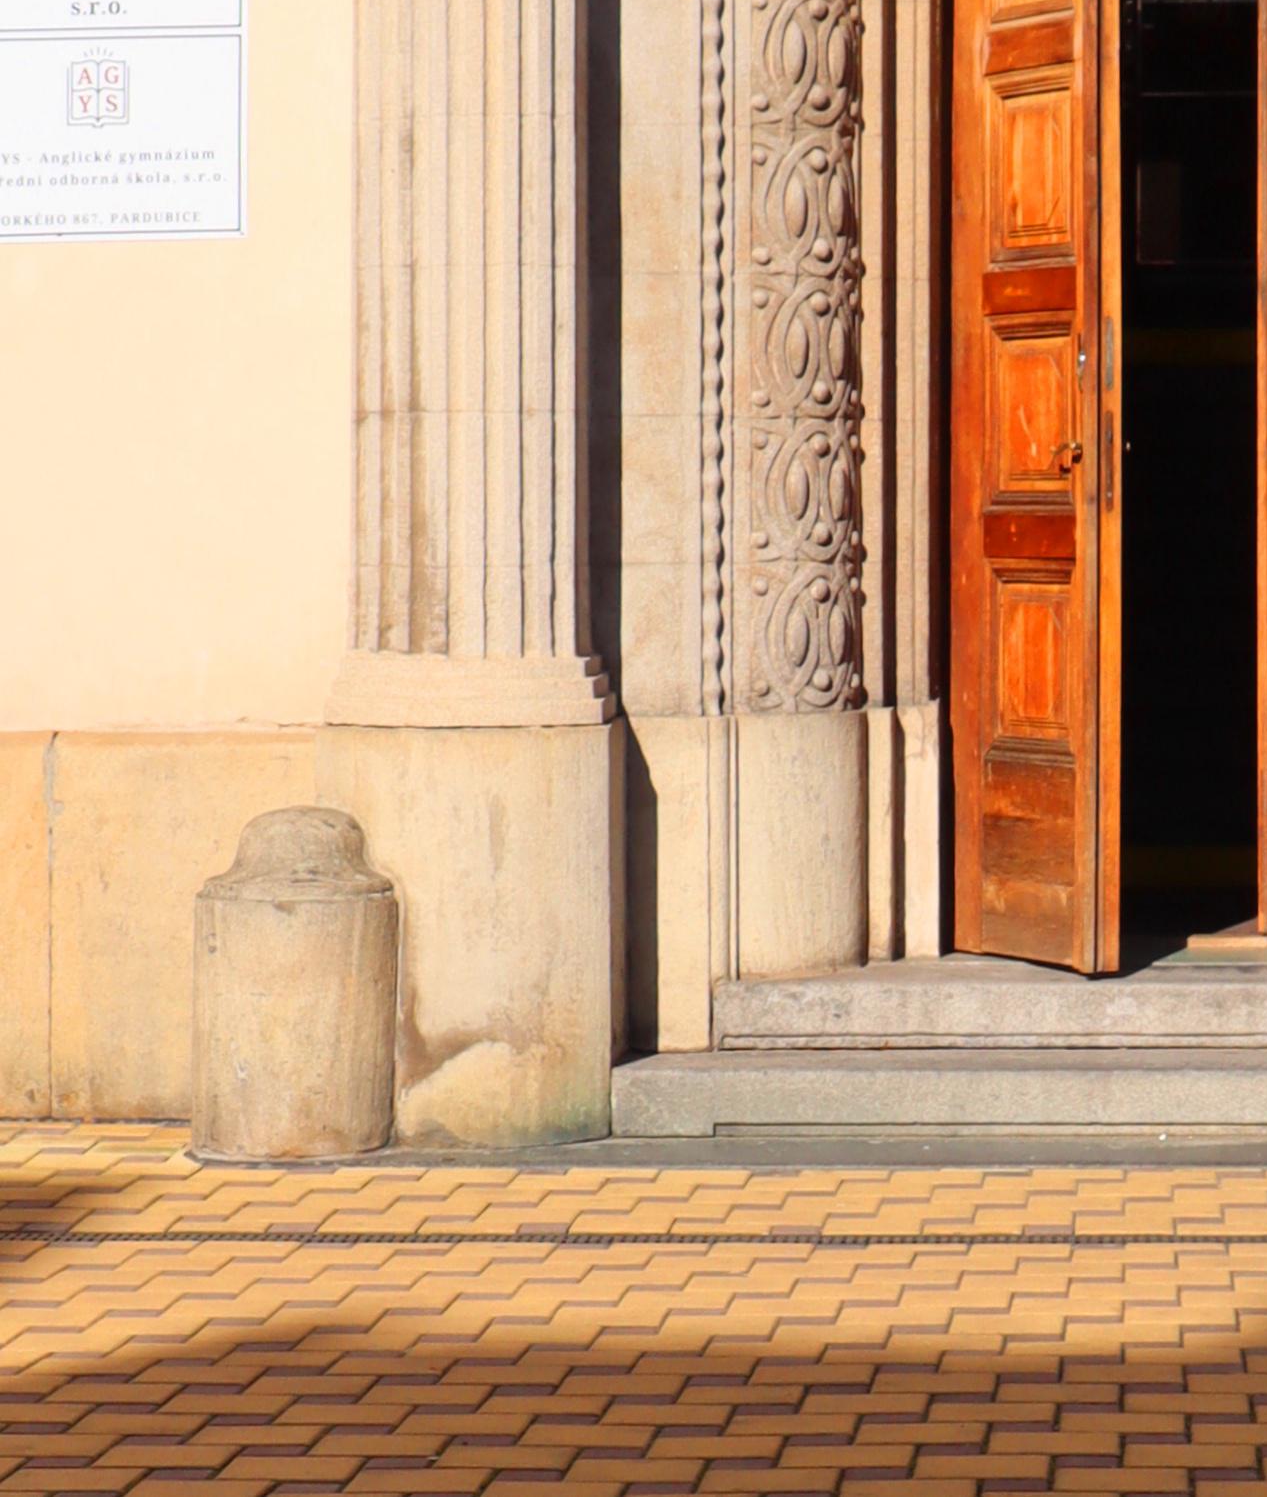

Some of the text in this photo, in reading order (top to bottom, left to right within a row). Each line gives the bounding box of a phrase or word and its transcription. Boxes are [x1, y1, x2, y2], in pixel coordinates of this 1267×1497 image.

[71, 1, 127, 15] s.r.o.
[40, 150, 112, 166] Anglické
[119, 147, 215, 165] gymnázium
[49, 172, 119, 185] odborná
[111, 211, 201, 224] PARDUBICE
